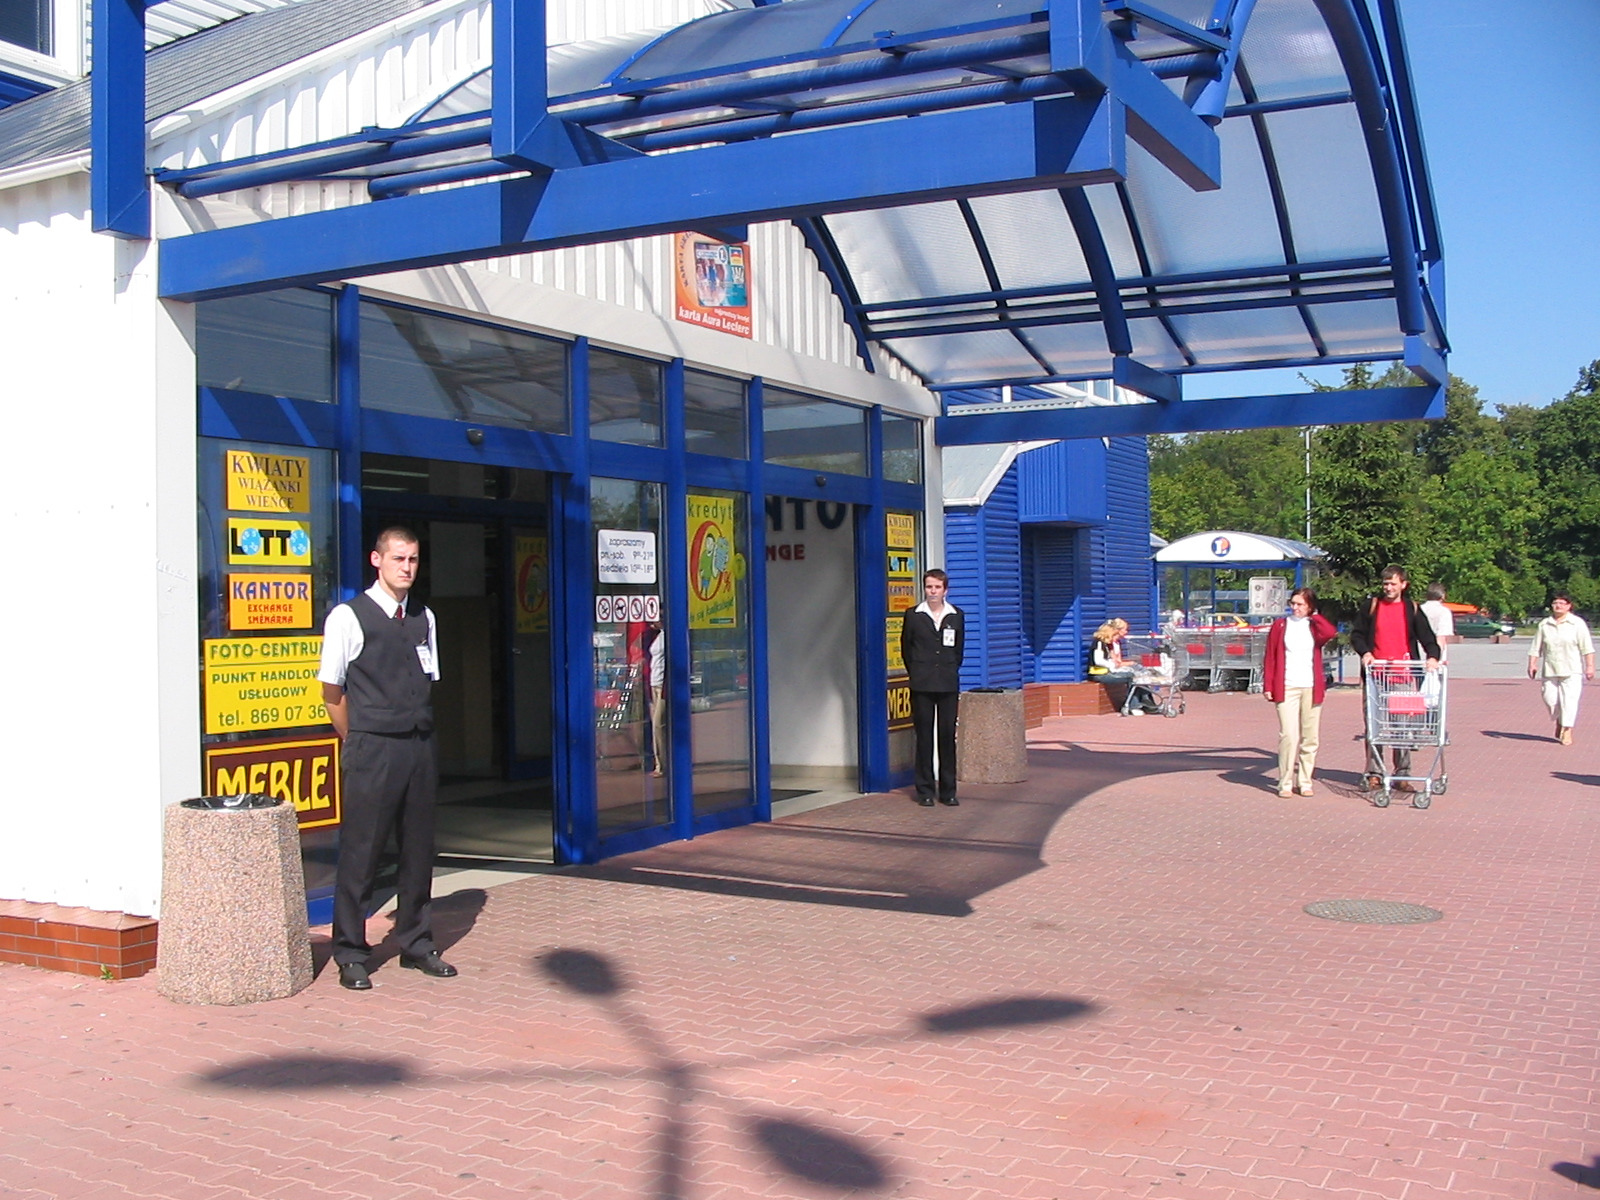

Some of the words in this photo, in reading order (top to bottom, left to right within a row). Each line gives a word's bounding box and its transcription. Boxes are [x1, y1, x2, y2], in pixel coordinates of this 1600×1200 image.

[702, 312, 721, 328] Aura
[722, 317, 750, 335] Leclerc
[232, 455, 307, 478] KWIATY
[687, 498, 732, 524] kredyt
[232, 581, 309, 602] KANTOR
[247, 603, 294, 613] EXCHANGE
[212, 671, 256, 684] PUNKT
[239, 686, 308, 701] USŁUGOWY
[219, 710, 245, 727] tel.
[250, 708, 280, 724] 869
[285, 706, 303, 722] 07
[308, 704, 326, 720] 36
